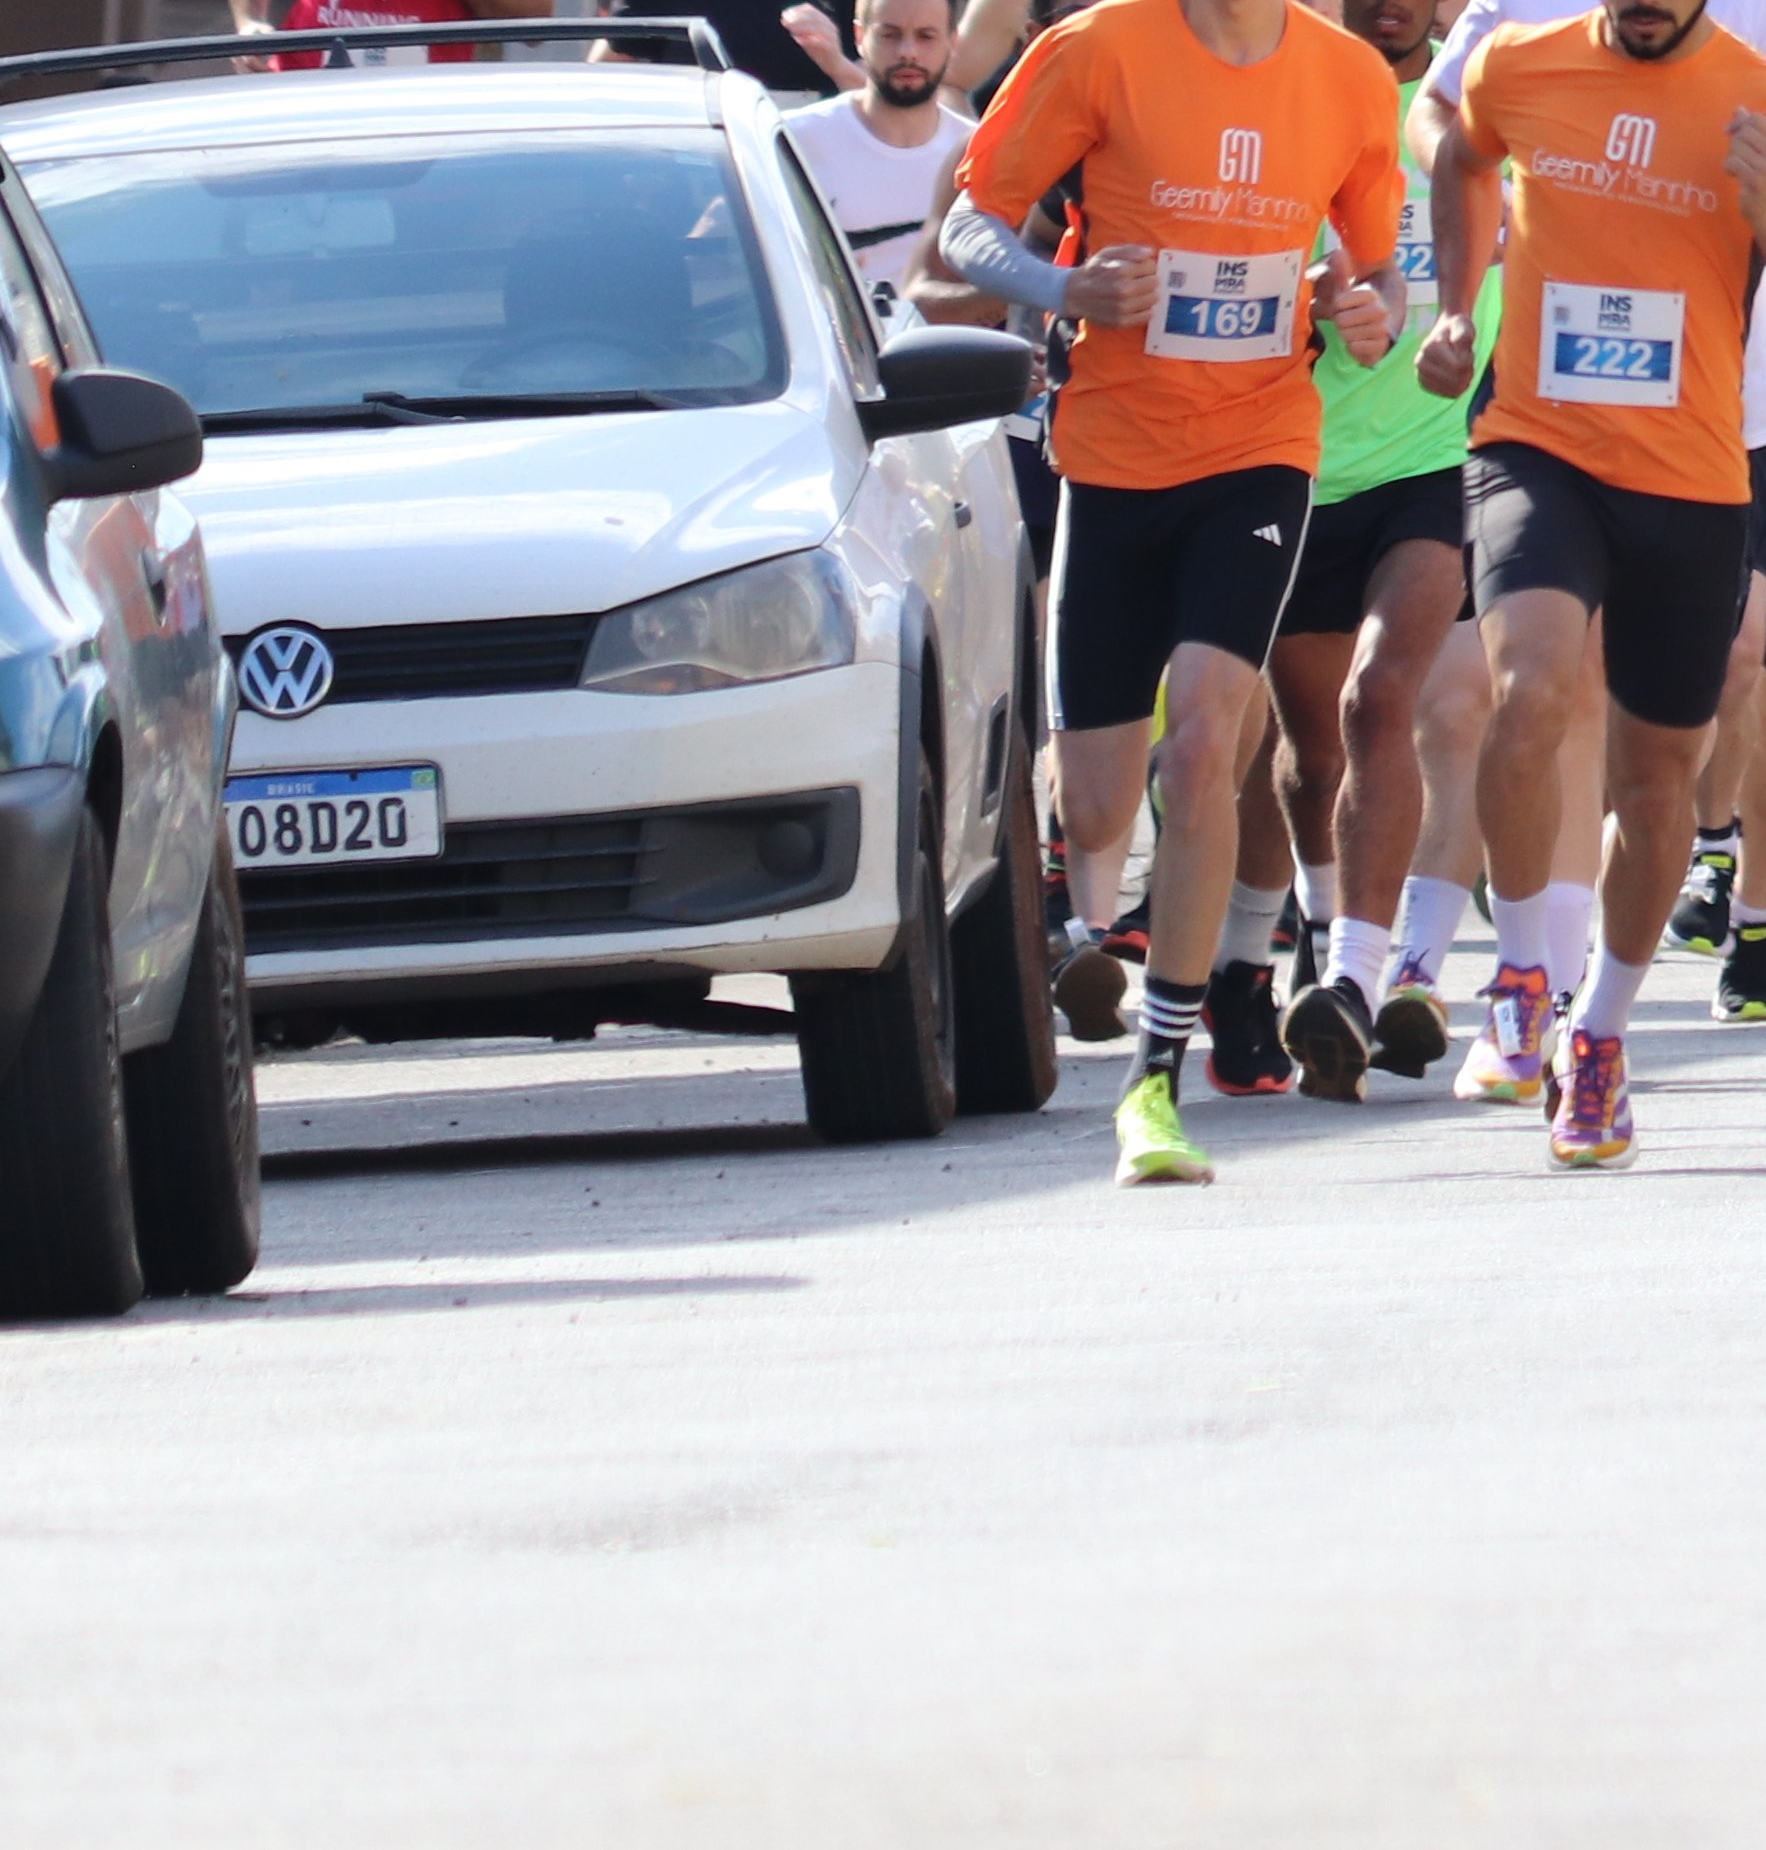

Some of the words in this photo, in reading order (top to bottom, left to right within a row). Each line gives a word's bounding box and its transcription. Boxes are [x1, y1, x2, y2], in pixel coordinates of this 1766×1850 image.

[1216, 260, 1248, 277] INS
[1600, 293, 1632, 312] INS
[1190, 300, 1263, 337] 169
[1573, 336, 1653, 379] 222
[266, 782, 316, 796] BRASIL
